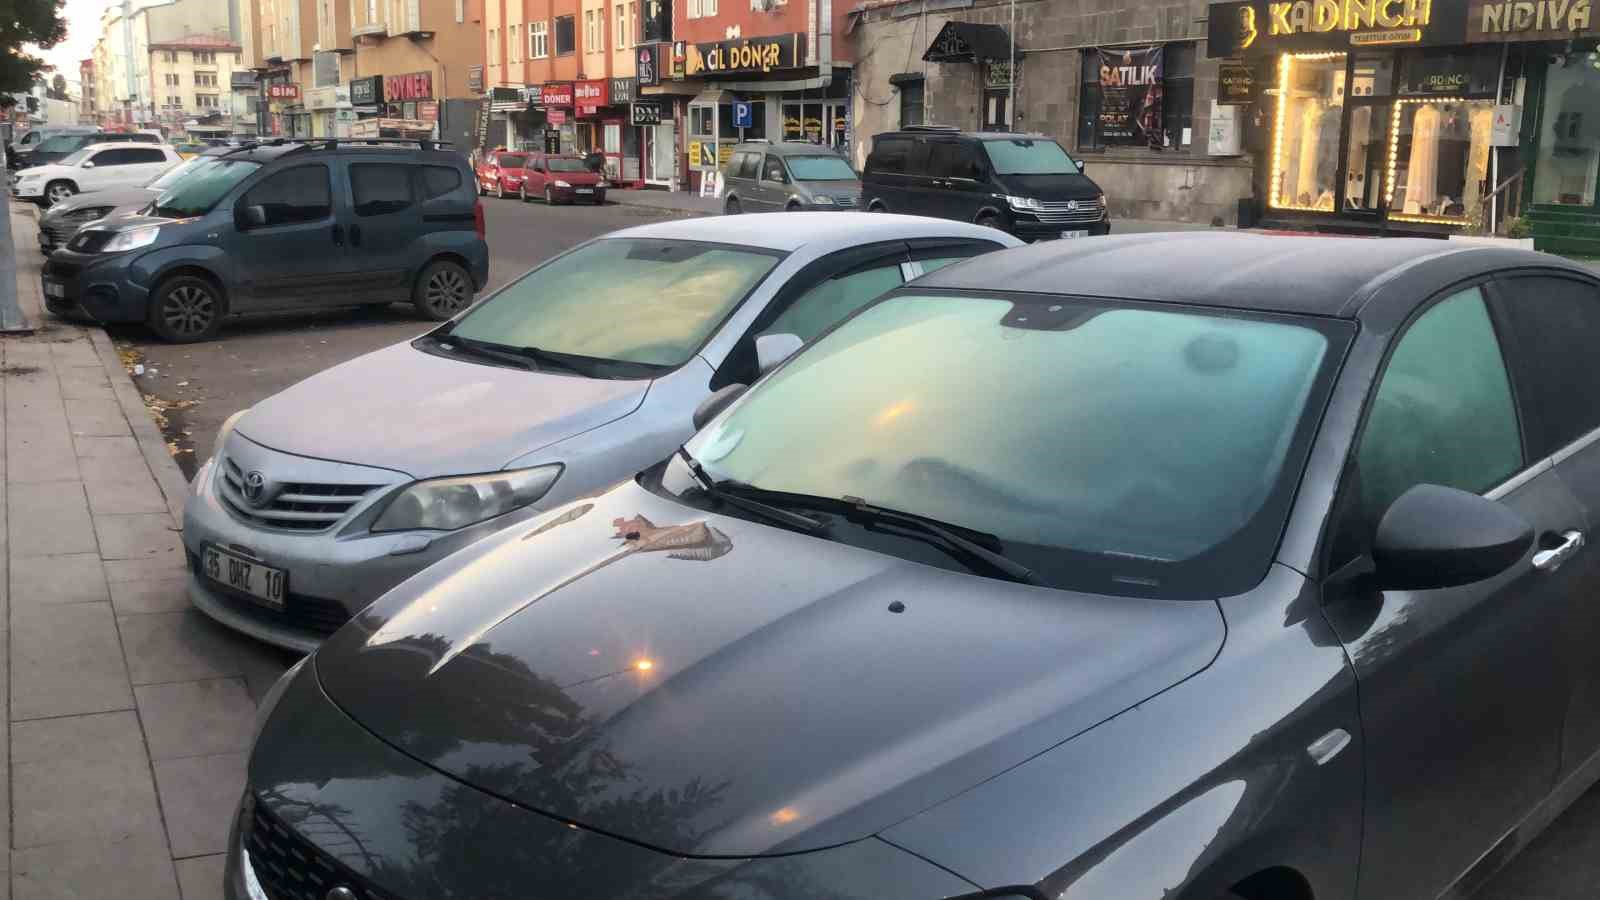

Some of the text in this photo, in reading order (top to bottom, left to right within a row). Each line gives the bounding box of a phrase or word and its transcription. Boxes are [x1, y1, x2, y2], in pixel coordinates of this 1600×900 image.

[730, 39, 780, 72] DÖNER
[385, 74, 428, 99] BOYNER
[1100, 64, 1157, 87] SATILIK
[272, 85, 297, 97] BİM
[736, 103, 748, 125] P
[265, 571, 281, 600] 10
